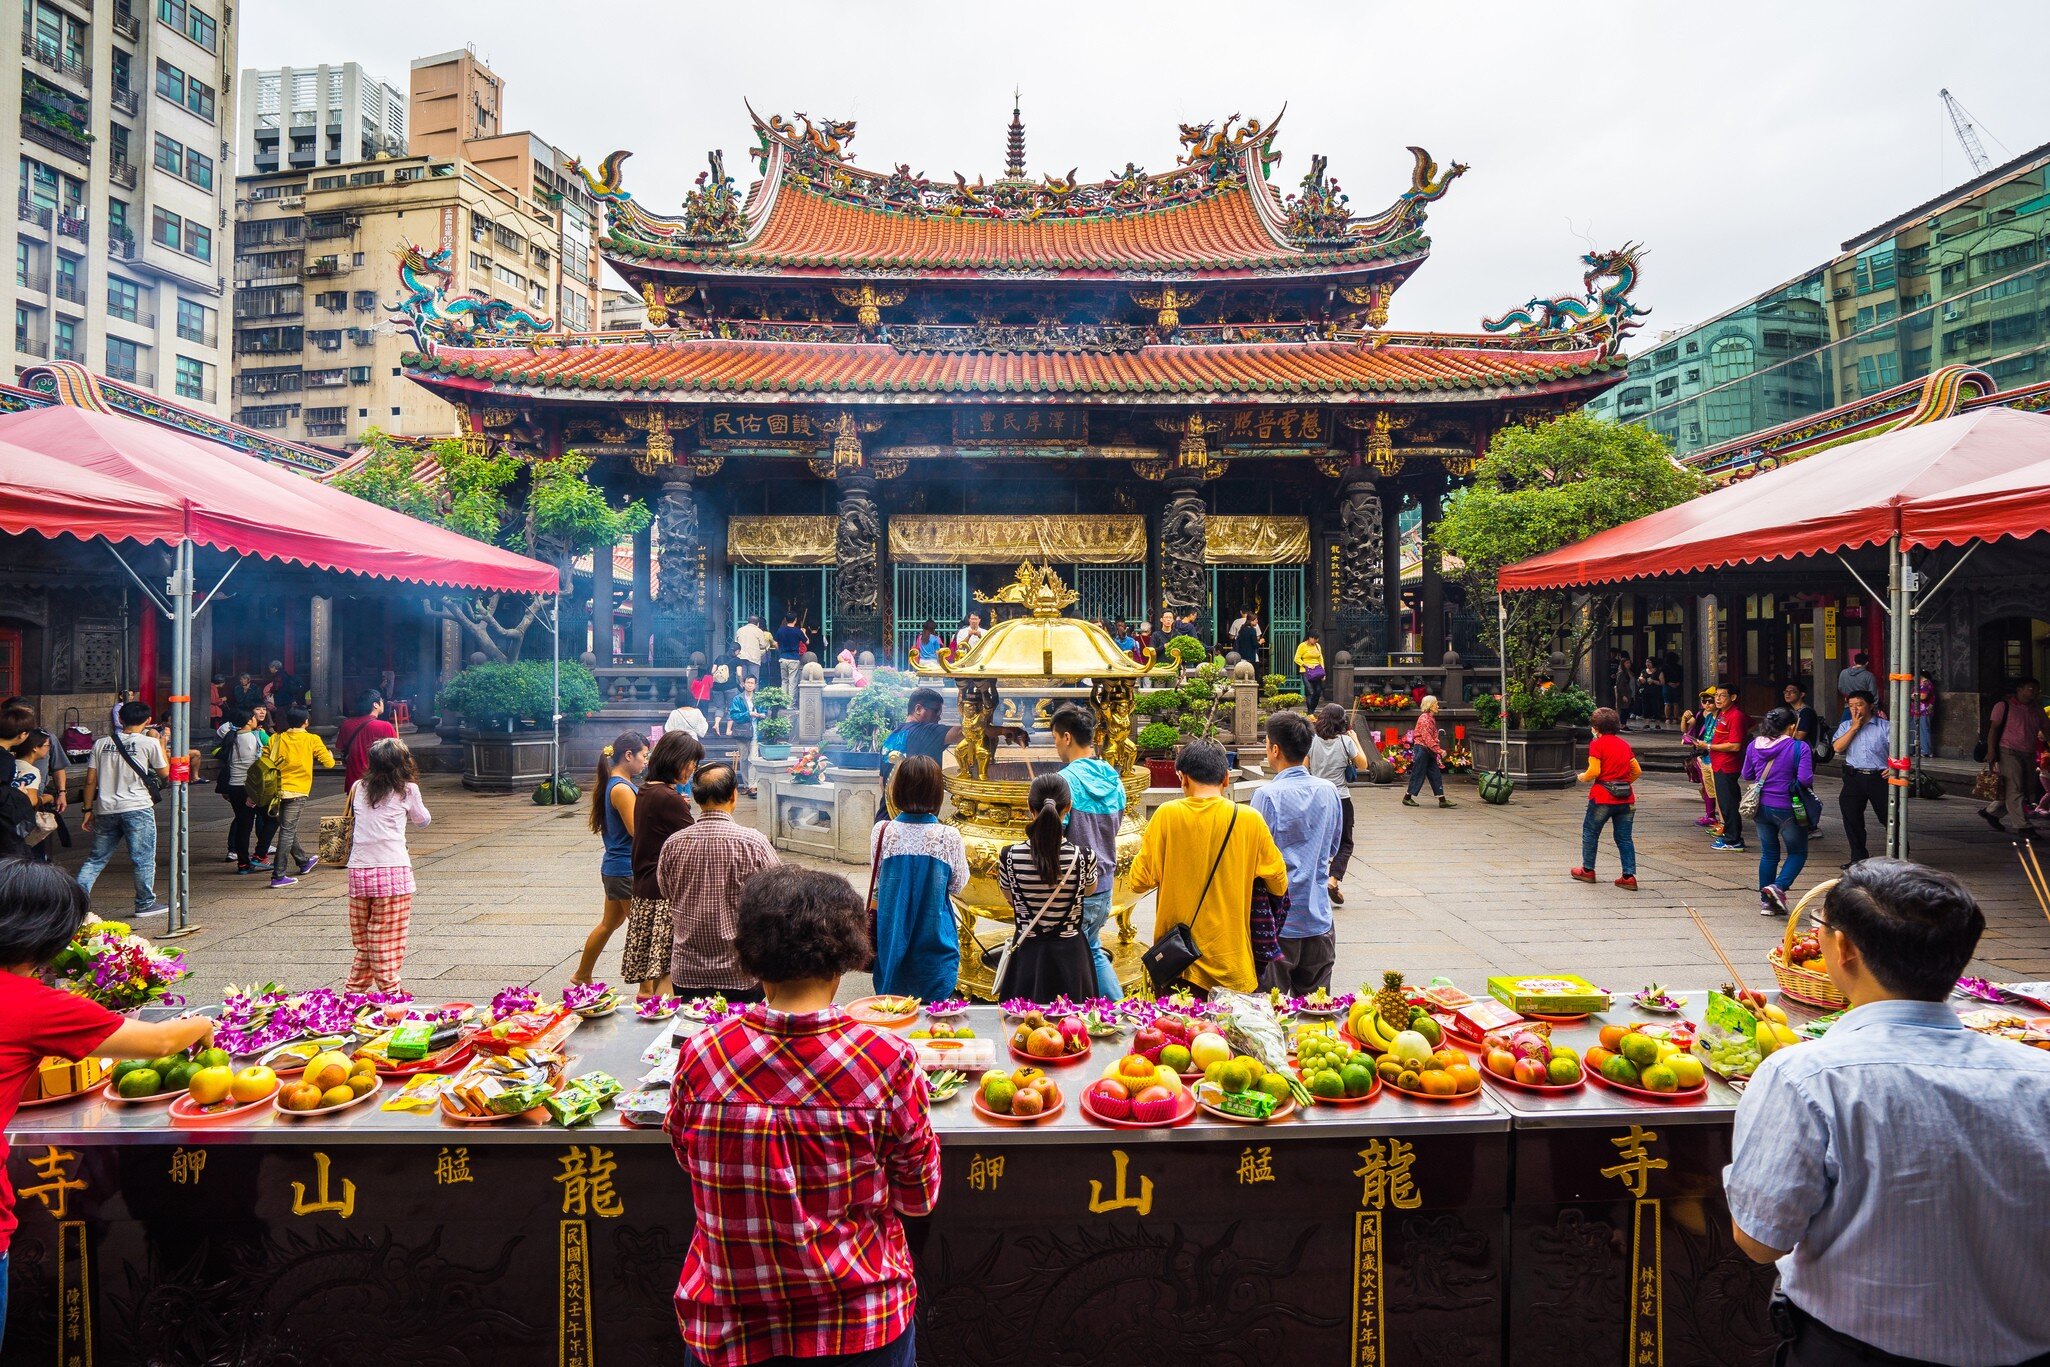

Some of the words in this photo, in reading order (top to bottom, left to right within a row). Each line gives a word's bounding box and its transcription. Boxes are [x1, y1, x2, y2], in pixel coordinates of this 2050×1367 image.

[17, 1145, 88, 1219] 寺
[168, 1147, 207, 1184] 舺
[291, 1152, 356, 1219] 山
[434, 1147, 474, 1185] 艋
[554, 1145, 624, 1218] 龍
[967, 1154, 1005, 1191] 舺
[1089, 1150, 1154, 1216] 山
[1237, 1147, 1276, 1185] 艋
[1353, 1138, 1423, 1210] 龍
[1601, 1125, 1669, 1199] 寺
